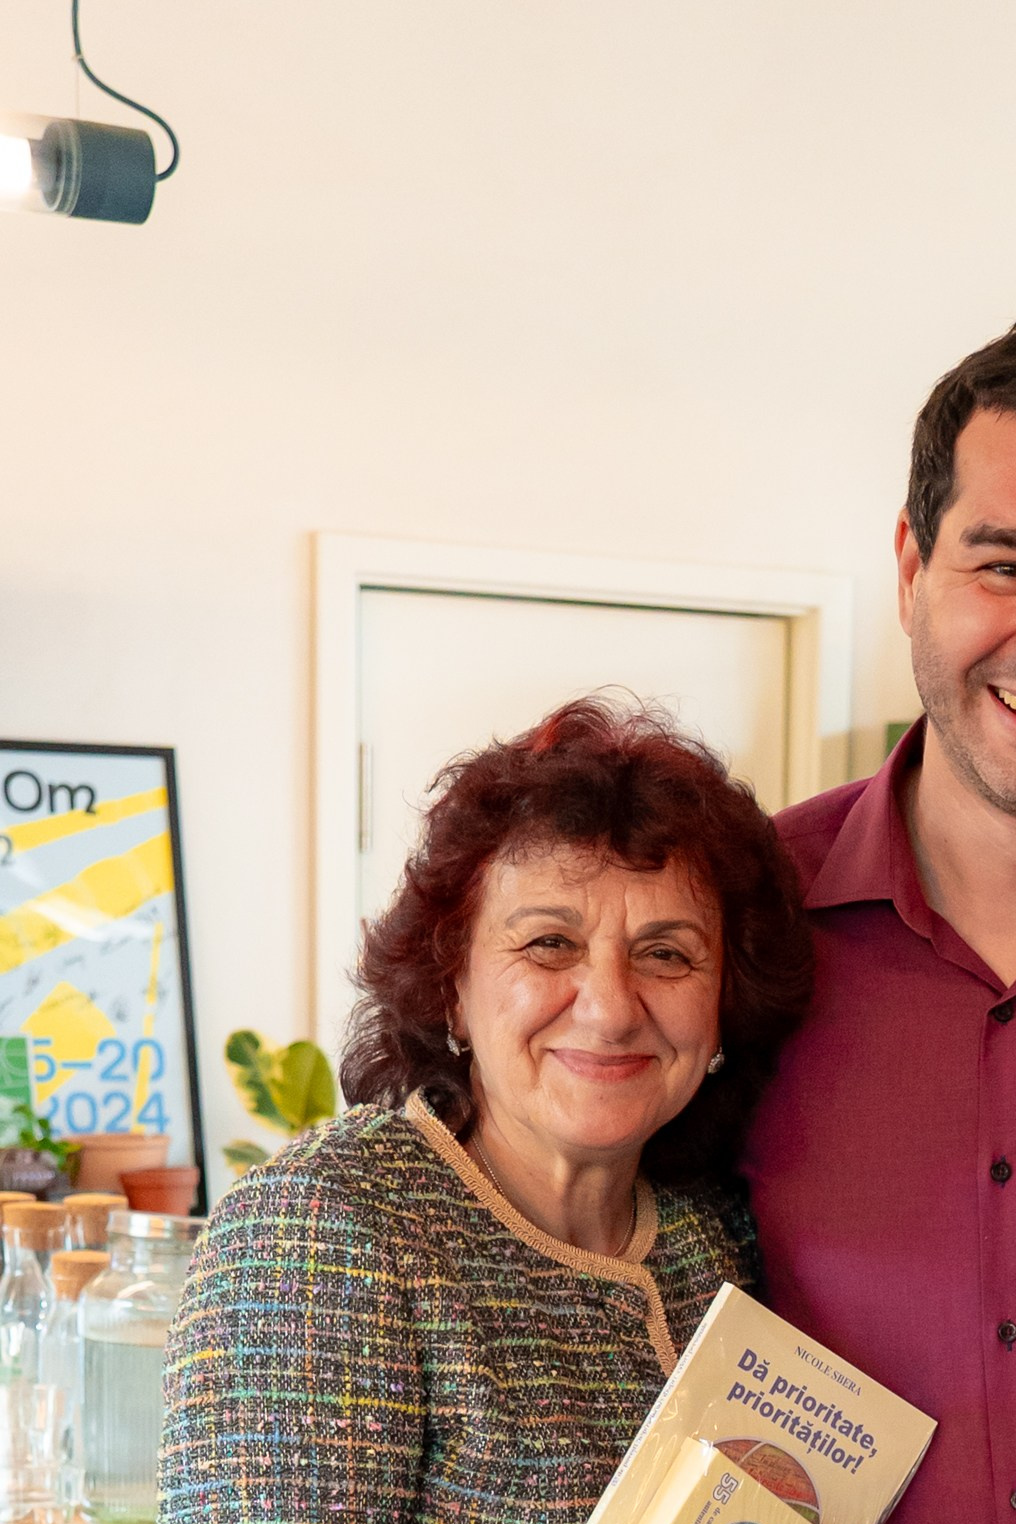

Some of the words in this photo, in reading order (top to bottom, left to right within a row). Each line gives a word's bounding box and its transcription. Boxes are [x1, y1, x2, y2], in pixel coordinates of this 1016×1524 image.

[794, 1346, 831, 1376] NICOLE
[831, 1370, 862, 1397] SBERA
[726, 1381, 865, 1475] priorităților!
[737, 1348, 770, 1382] Dă
[769, 1375, 878, 1458] prioritate,
[713, 1472, 739, 1505] 55
[713, 1507, 721, 1517] de
